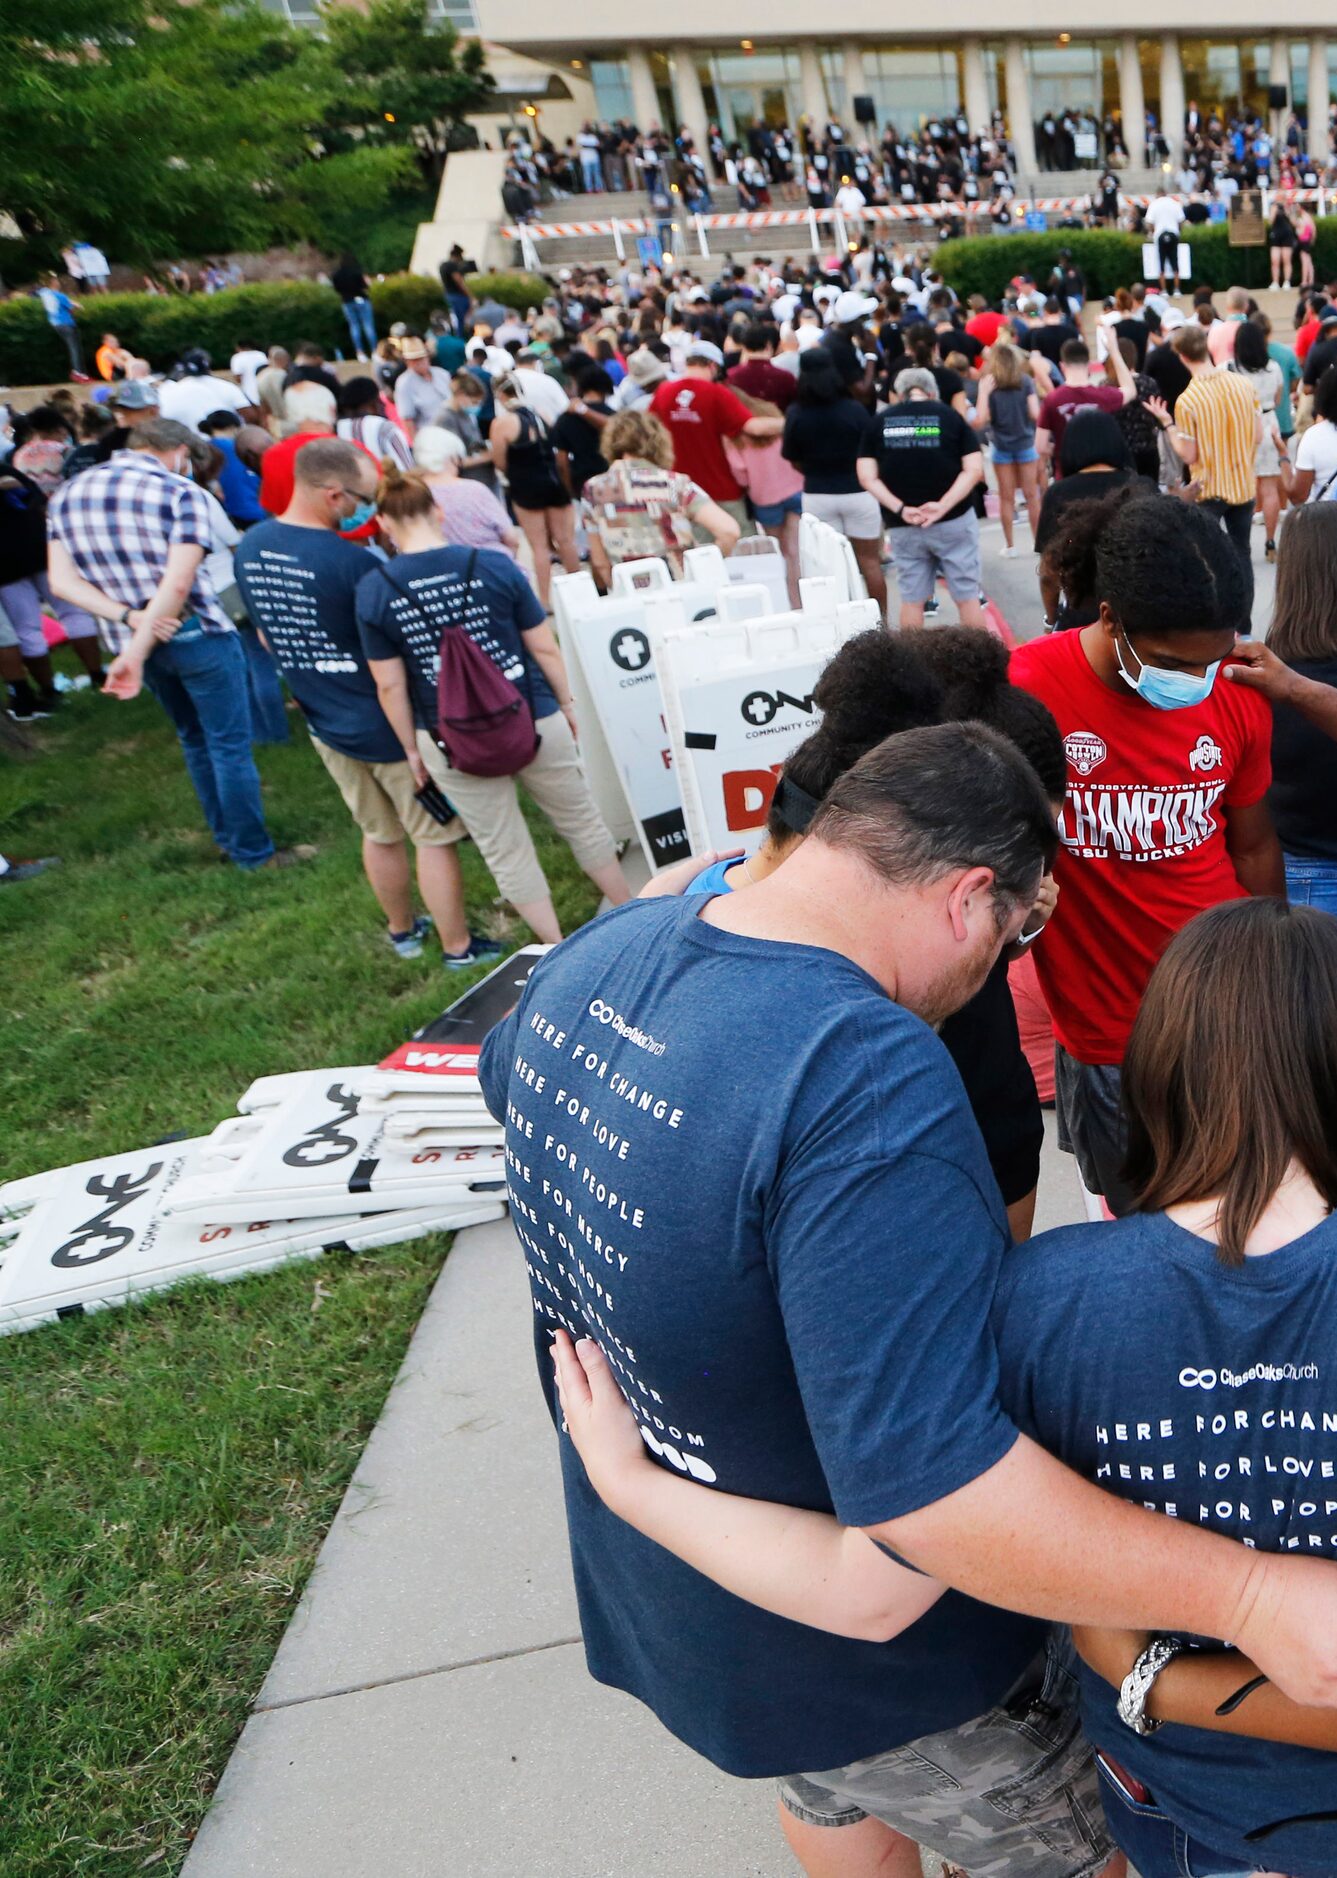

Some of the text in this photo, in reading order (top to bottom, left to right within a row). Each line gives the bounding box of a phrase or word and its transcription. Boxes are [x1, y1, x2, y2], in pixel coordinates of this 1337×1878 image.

[741, 690, 817, 727] ON
[745, 722, 803, 739] COMMUNITY
[1065, 743, 1103, 757] COTTON
[1153, 783, 1195, 791] COTTON
[1200, 779, 1222, 788] BOWL
[1057, 784, 1225, 852] CHAMPIONS
[1067, 847, 1108, 859] OSU
[530, 1012, 684, 1129] HERE FOR CHANGE
[514, 1055, 631, 1160] HERE FOR LOVE
[544, 1134, 577, 1172] FOR
[582, 1167, 645, 1229] PEOPLE
[51, 1161, 164, 1268] ONE
[542, 1179, 572, 1217] FOR
[577, 1214, 629, 1272] MERCY
[525, 1260, 562, 1301] HERE
[578, 1259, 614, 1312] HOPE
[534, 1297, 576, 1334] HERE
[586, 1302, 637, 1363] GRACE
[1096, 1418, 1173, 1444] HERE
[1196, 1410, 1249, 1435] FOR
[1097, 1455, 1335, 1481] HERE FOR LOVE
[1200, 1501, 1251, 1521] FOR
